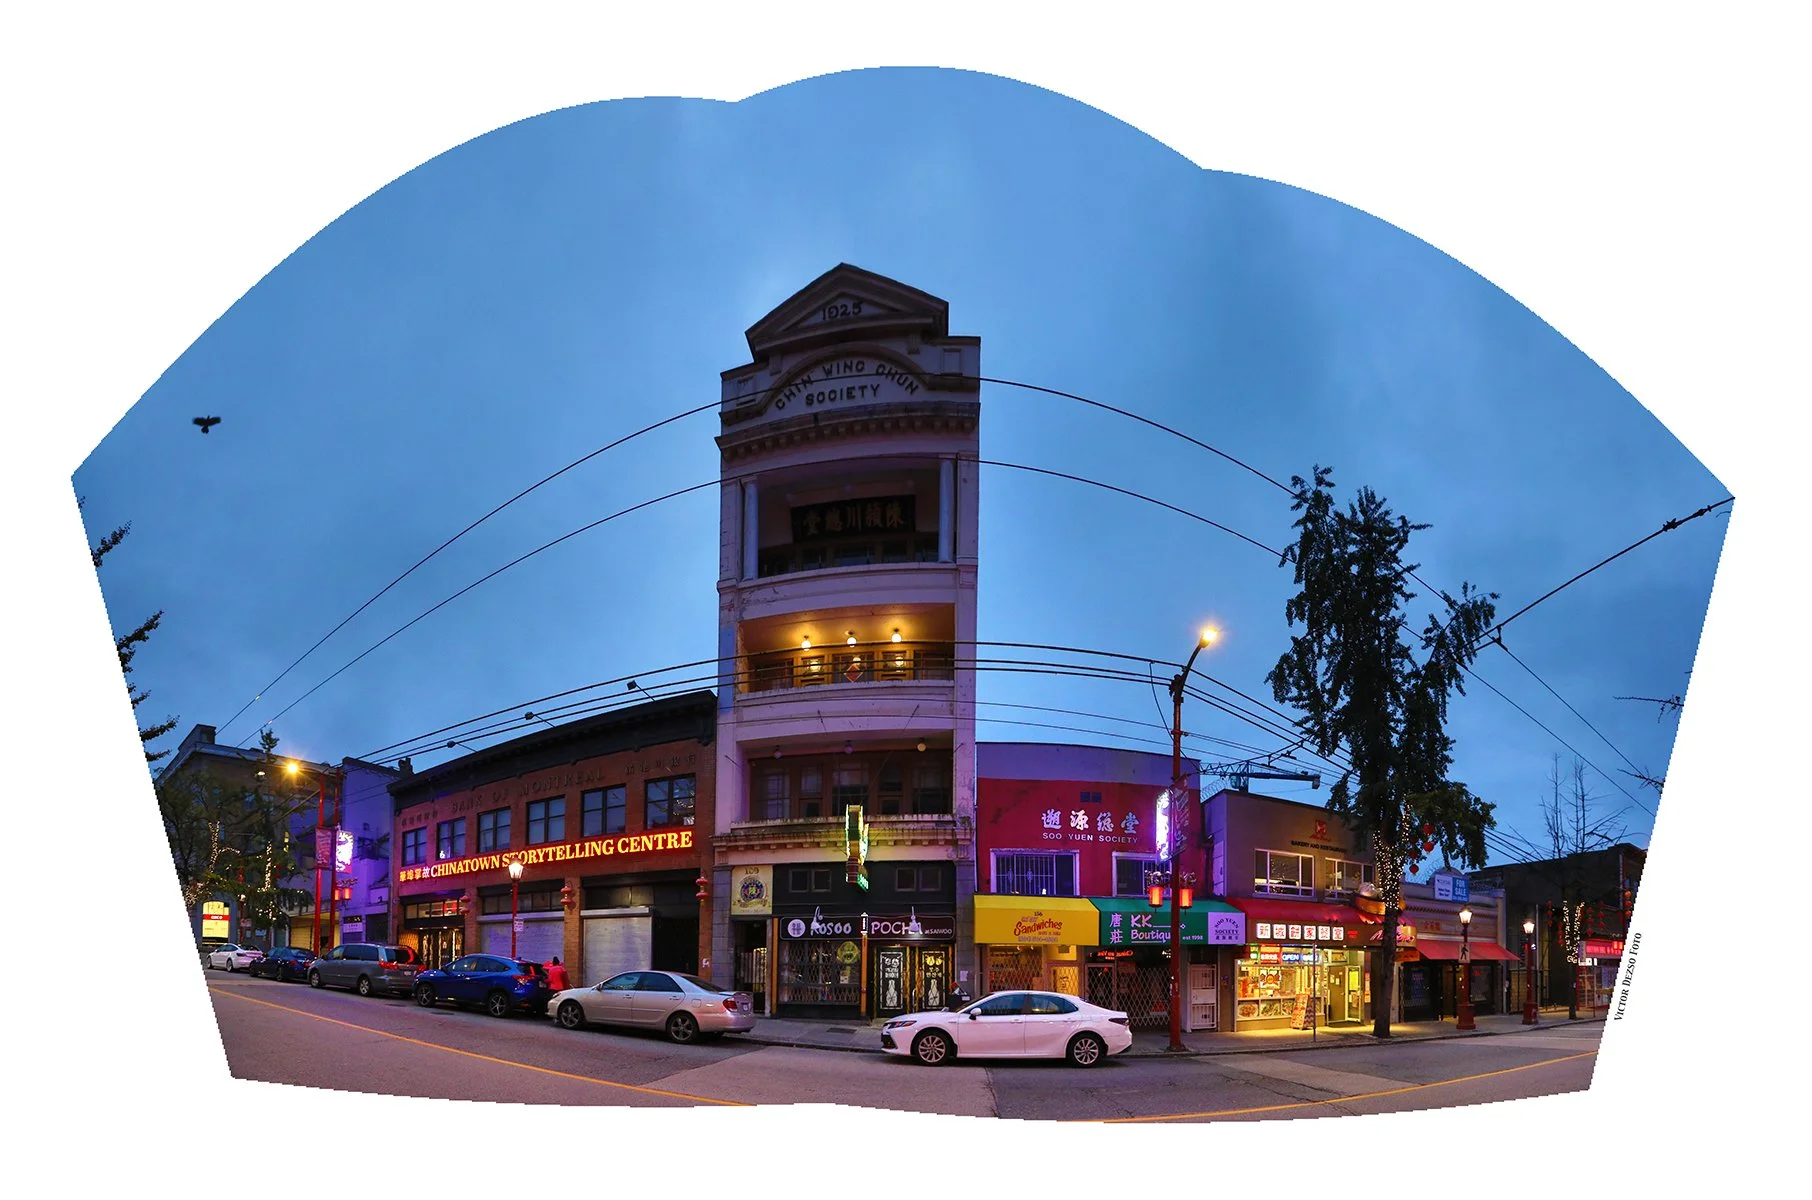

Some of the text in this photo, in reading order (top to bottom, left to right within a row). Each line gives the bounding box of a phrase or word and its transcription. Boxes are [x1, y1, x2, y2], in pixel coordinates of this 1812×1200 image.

[822, 301, 863, 320] 1925
[775, 360, 919, 409] CHIN WING CHUN
[805, 383, 880, 406] SOCIETY
[519, 767, 606, 797] MONTREAL
[1042, 832, 1138, 844] SOO YUEN SOCIETY
[430, 831, 693, 878] CHINATOWN STORYTELLING CENTRE
[1455, 887, 1466, 896] SALE
[1456, 879, 1465, 888] FOR
[1013, 918, 1063, 937] Sandwiches
[1131, 914, 1152, 928] KK
[1214, 917, 1239, 929] SOO YUEN
[1131, 929, 1171, 943] Boutiqu
